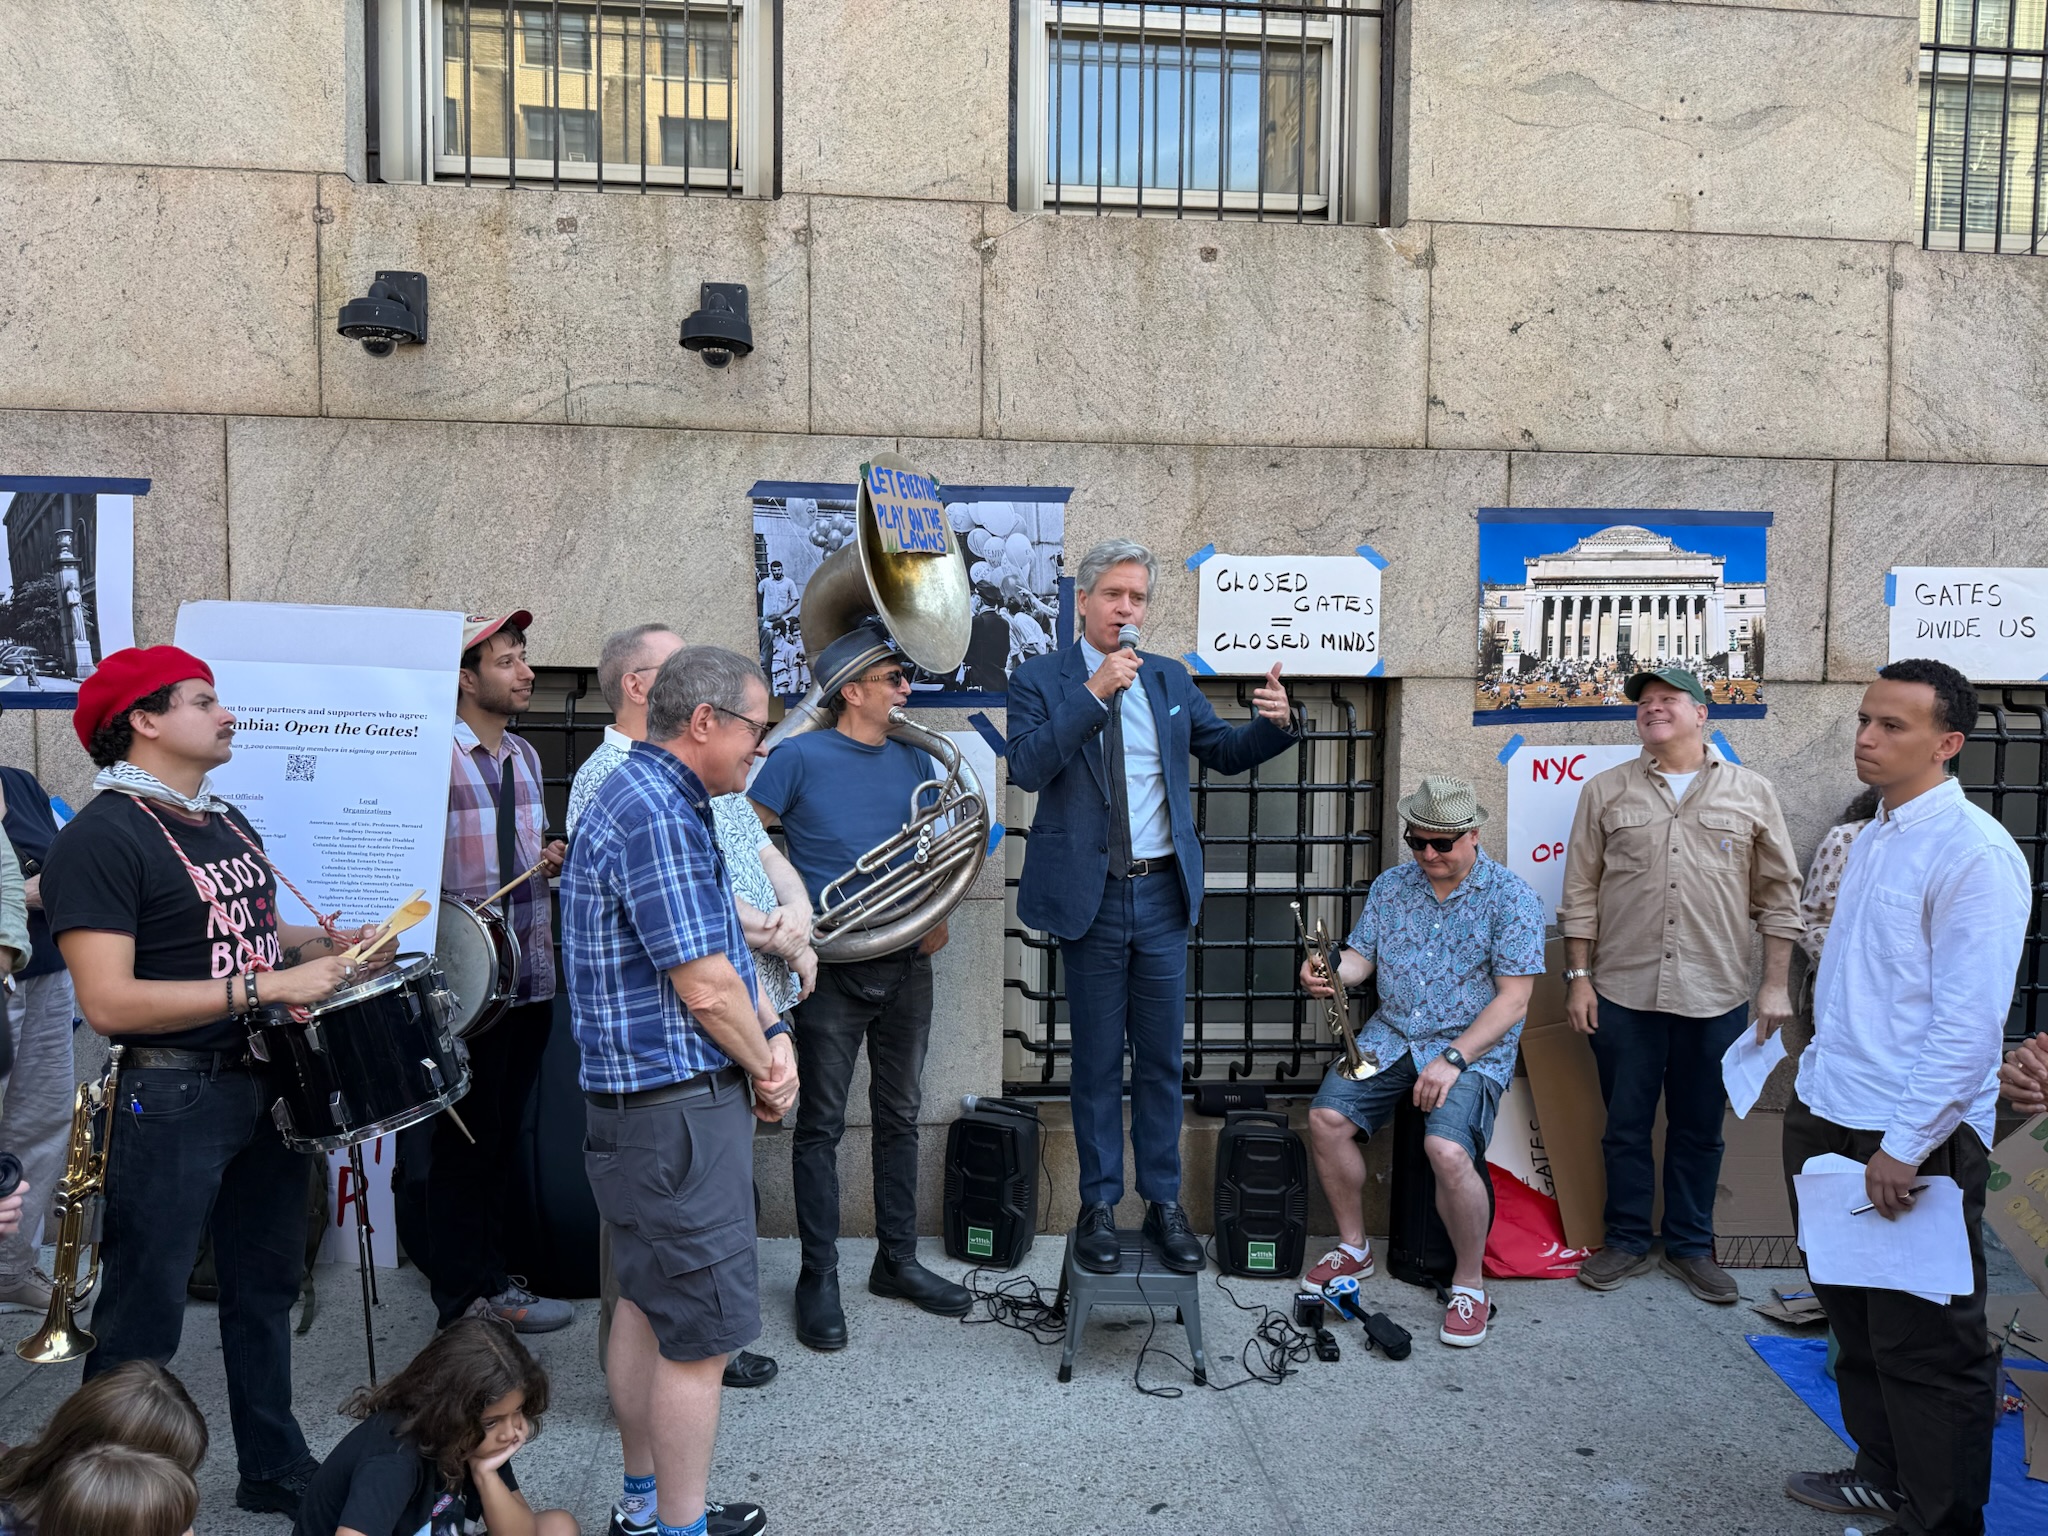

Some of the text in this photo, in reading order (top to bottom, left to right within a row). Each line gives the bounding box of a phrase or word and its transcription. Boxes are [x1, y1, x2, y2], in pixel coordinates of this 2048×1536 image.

[868, 466, 896, 497] LET
[876, 504, 905, 530] PLAY
[907, 507, 924, 533] ON
[922, 507, 943, 531] THE
[898, 528, 946, 552] LAWNS
[1216, 569, 1308, 592] CLOSED
[1294, 595, 1373, 615] GATES
[1915, 583, 2002, 607] GATES
[1916, 616, 2036, 639] DIVIDE US
[1214, 631, 1375, 652] CLOSED MINDS
[266, 706, 306, 714] partners
[327, 709, 377, 718] supporters
[378, 710, 397, 718] who
[232, 718, 419, 738] mbia: Open the Gates!
[348, 747, 375, 756] signing
[1533, 754, 1587, 785] NYC
[343, 807, 392, 815] Organizations
[1532, 842, 1564, 863] OP
[188, 852, 266, 902] BESOS
[207, 897, 255, 938] NOT
